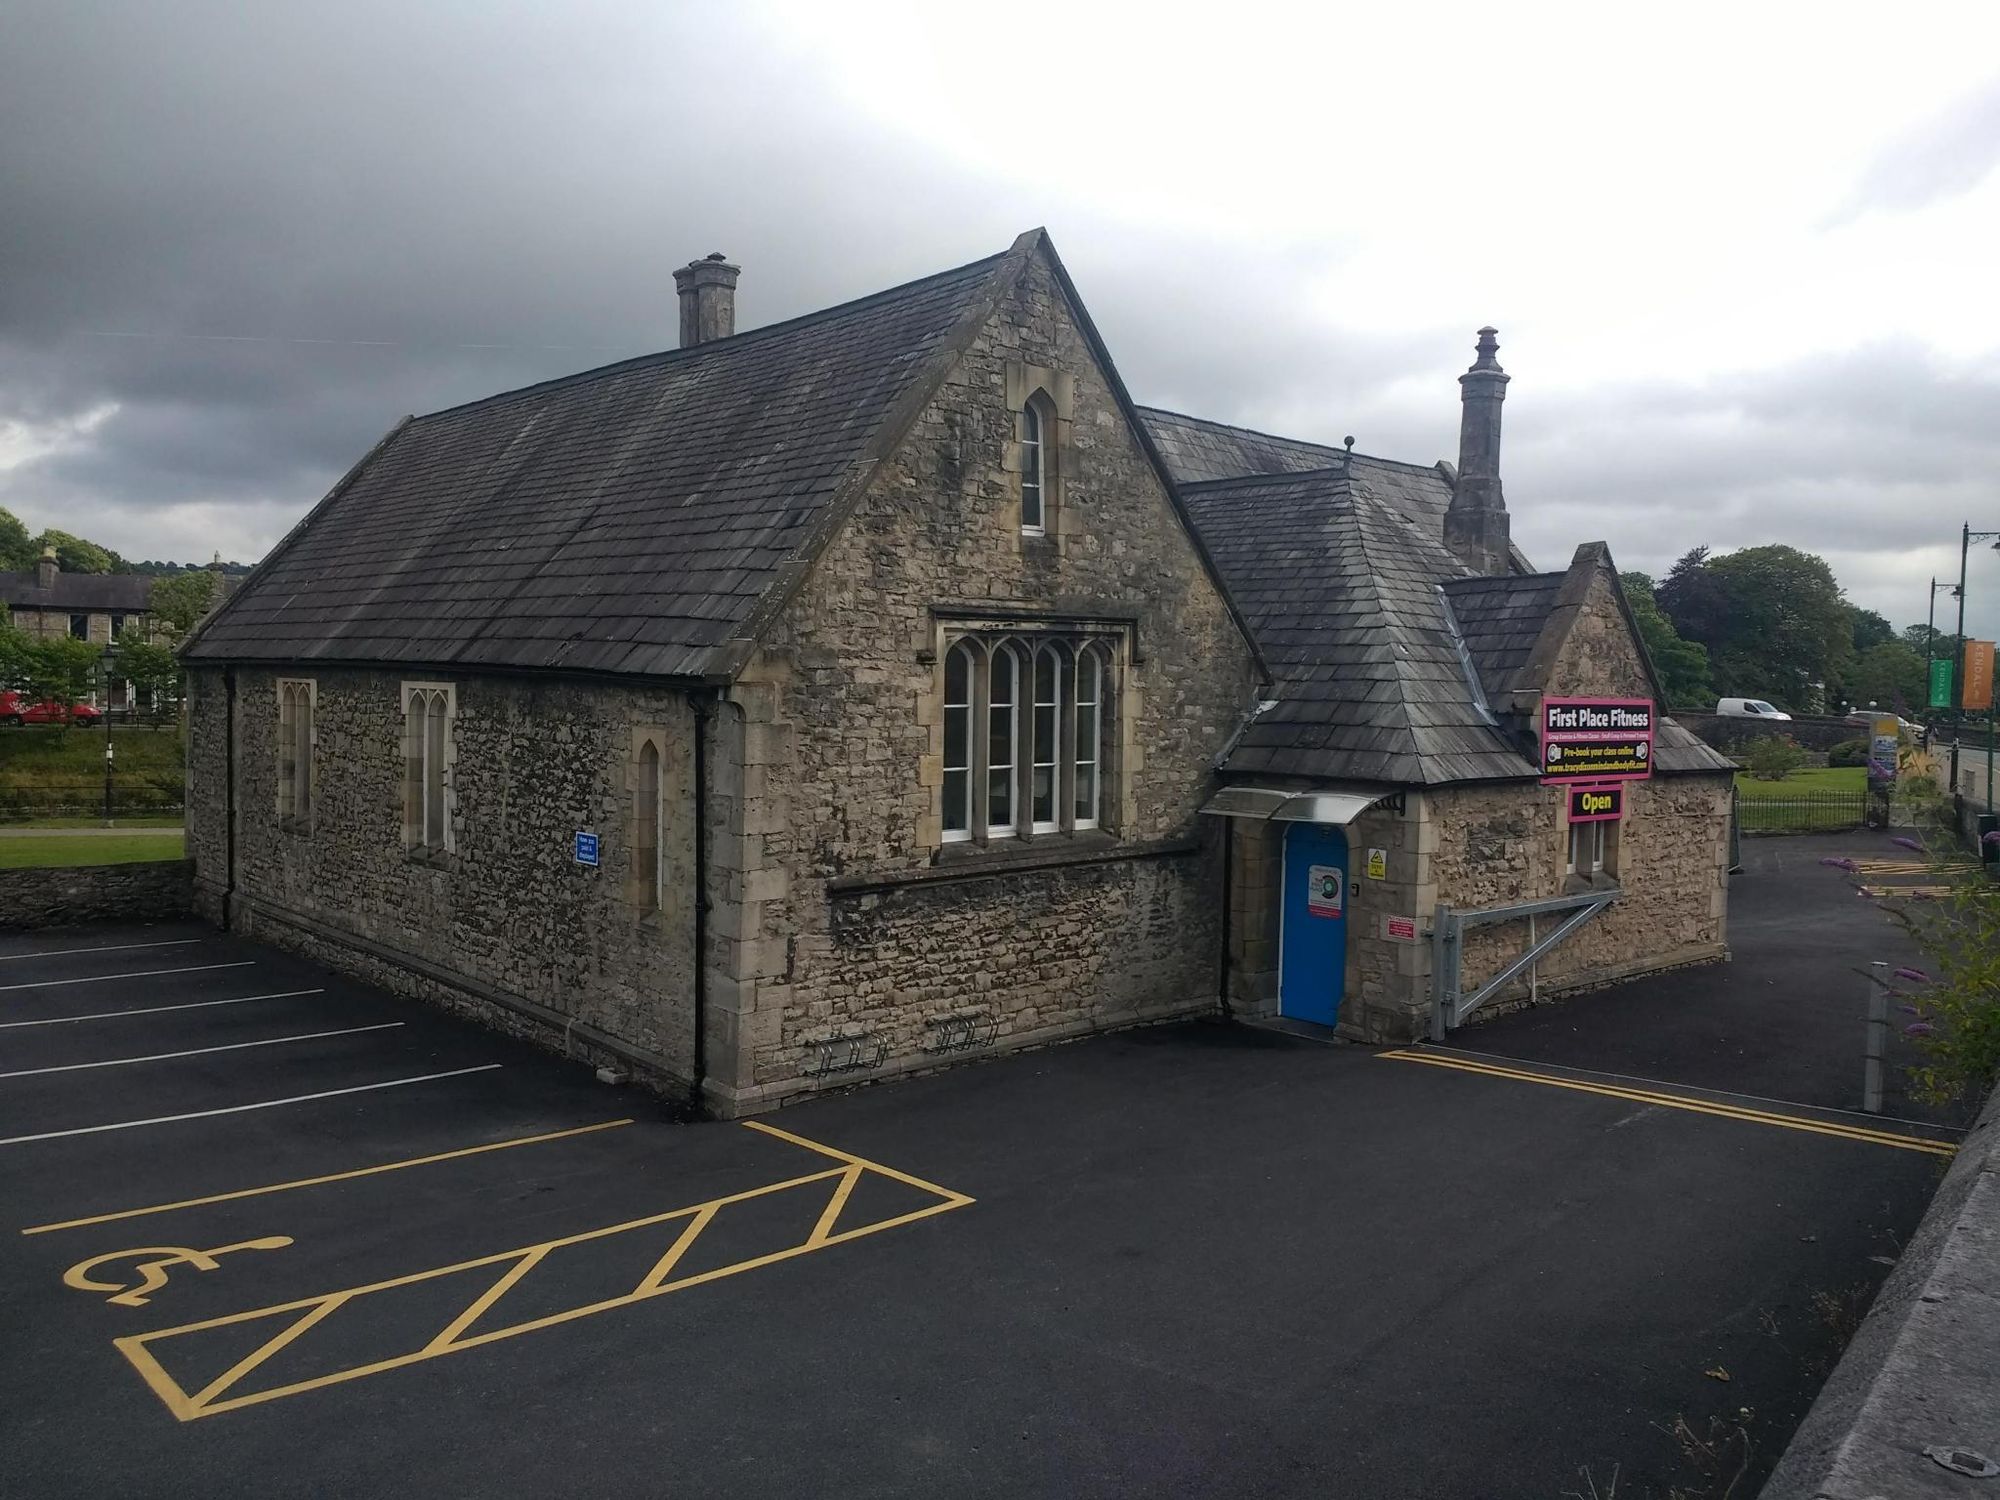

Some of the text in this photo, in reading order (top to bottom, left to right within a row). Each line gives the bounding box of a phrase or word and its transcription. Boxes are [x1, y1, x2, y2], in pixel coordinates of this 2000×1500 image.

[1973, 644, 1985, 688] KENDAL
[1549, 708, 1648, 727] First Place Fitness
[1582, 793, 1611, 814] Open
